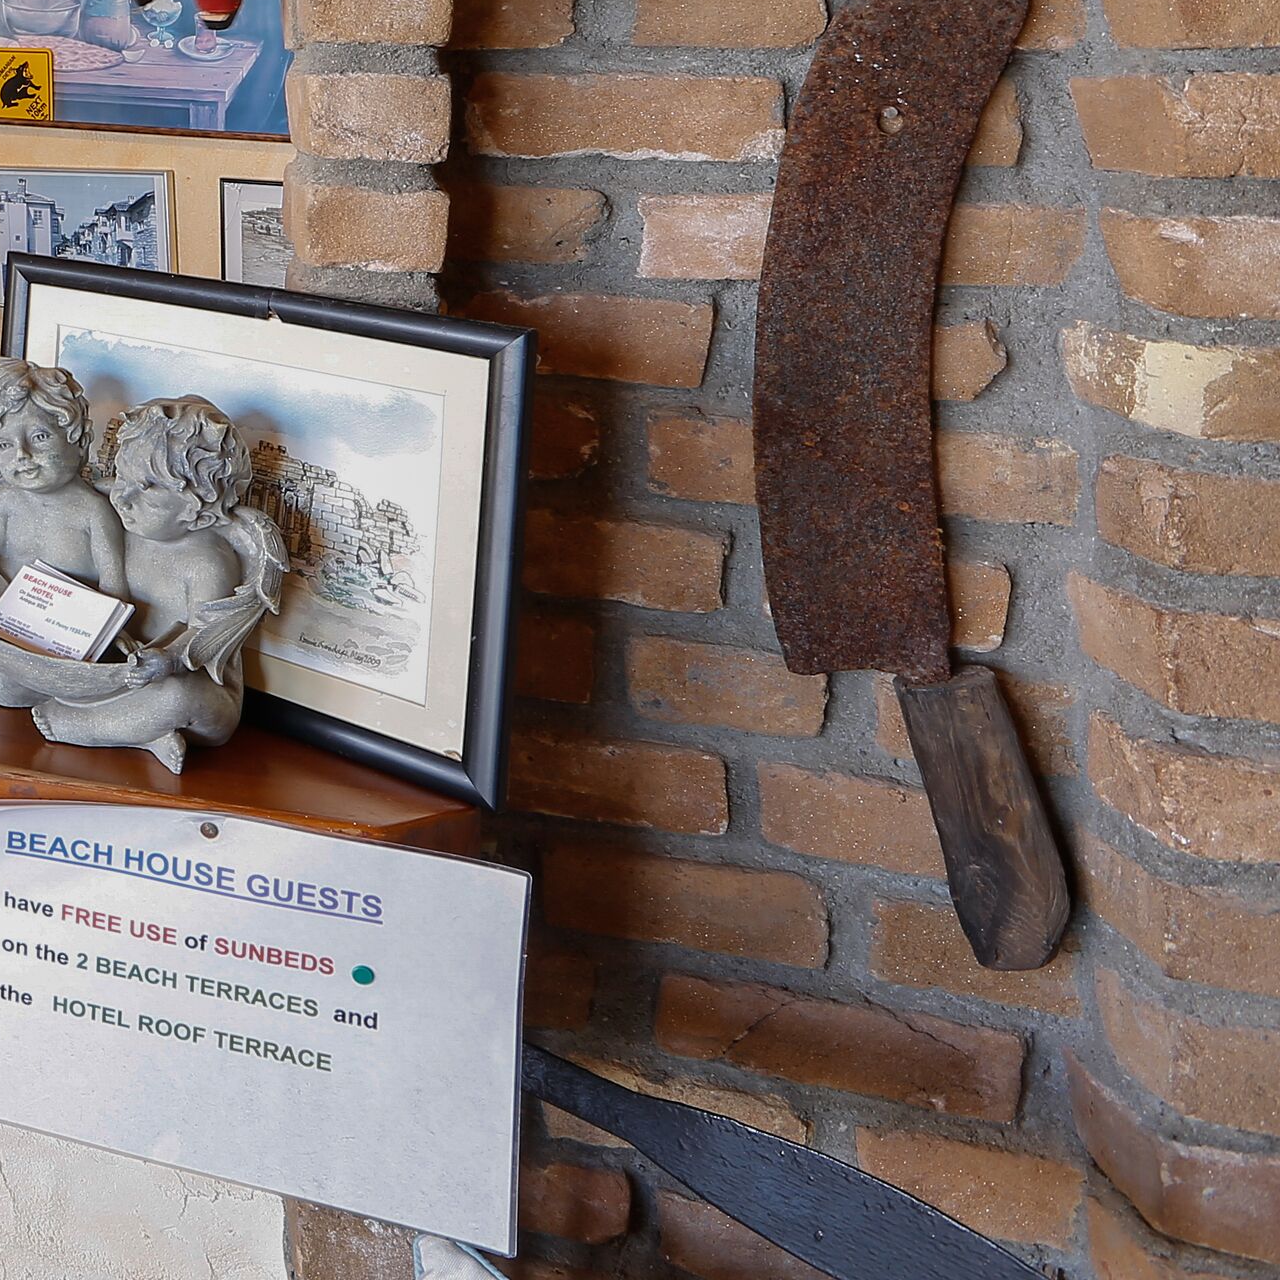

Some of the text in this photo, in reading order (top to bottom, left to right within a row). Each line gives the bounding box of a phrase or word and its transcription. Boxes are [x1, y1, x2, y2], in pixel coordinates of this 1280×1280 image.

[26, 95, 42, 115] NEXT
[23, 573, 73, 598] BEACH HOUSE
[31, 586, 54, 600] HOTEL
[364, 654, 381, 667] 2009
[7, 830, 383, 918] BEACH HOUSE GUESTS
[4, 892, 335, 976] have FREE USE of SUNBEDS
[1, 938, 379, 1031] on the 2 BEACH TERRACES and
[0, 983, 333, 1073] the HOTEL ROOF TERRACE
